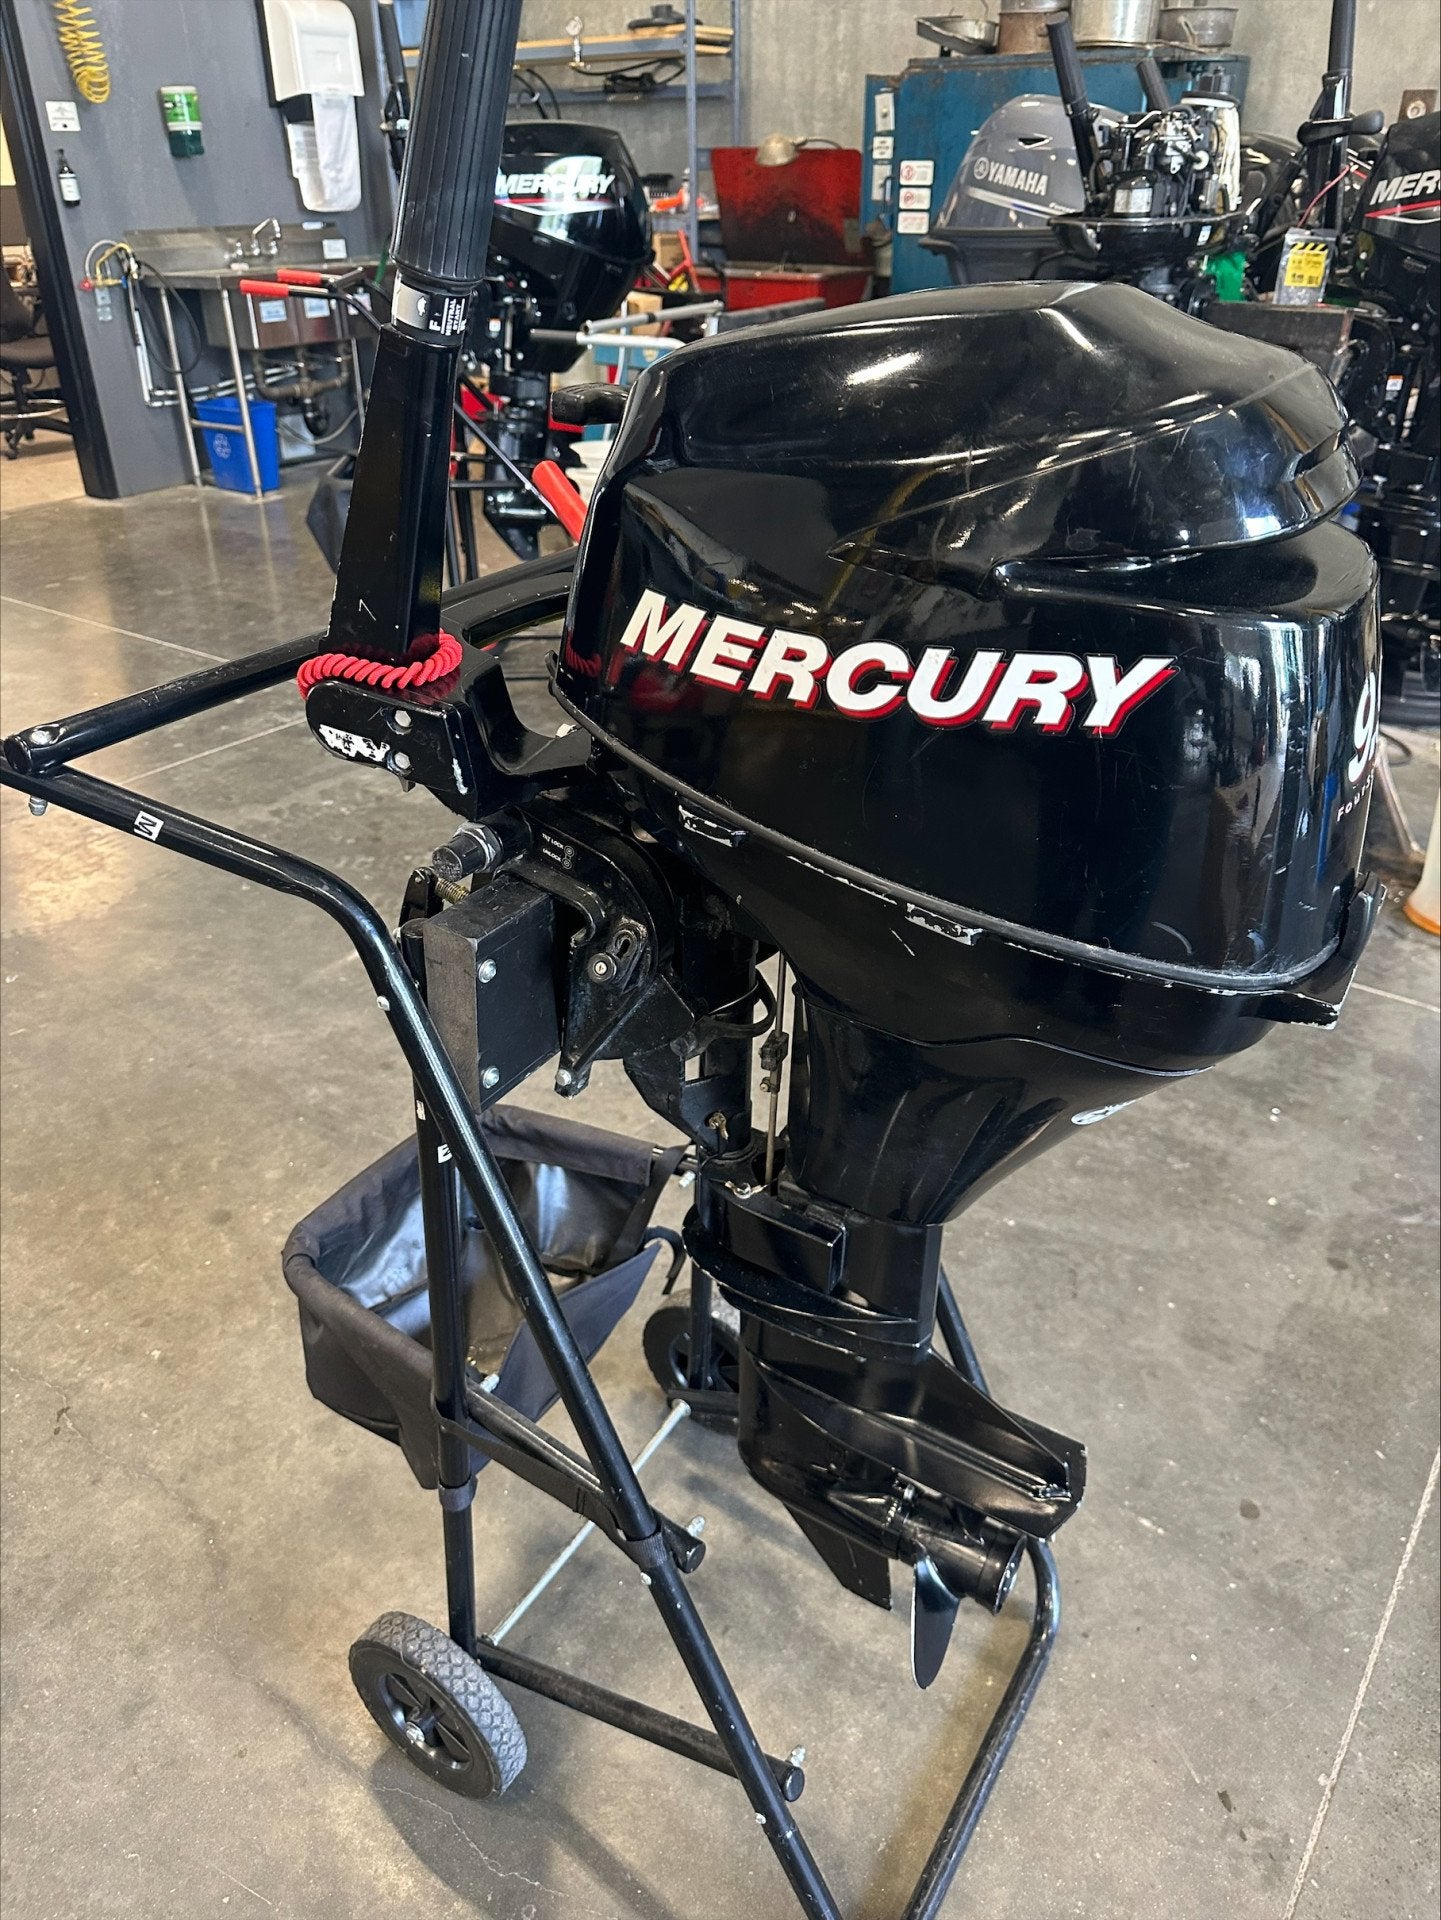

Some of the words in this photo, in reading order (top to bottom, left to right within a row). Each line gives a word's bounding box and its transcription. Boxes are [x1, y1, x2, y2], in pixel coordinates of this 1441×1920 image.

[494, 172, 616, 195] MERCURY
[987, 161, 1048, 197] YAMAHA
[1369, 169, 1440, 206] MER
[445, 298, 457, 336] NEUTRAL
[452, 303, 462, 331] START
[619, 588, 1178, 736] MERCURY
[542, 848, 562, 862] UNLOCK
[551, 838, 564, 850] LOCK
